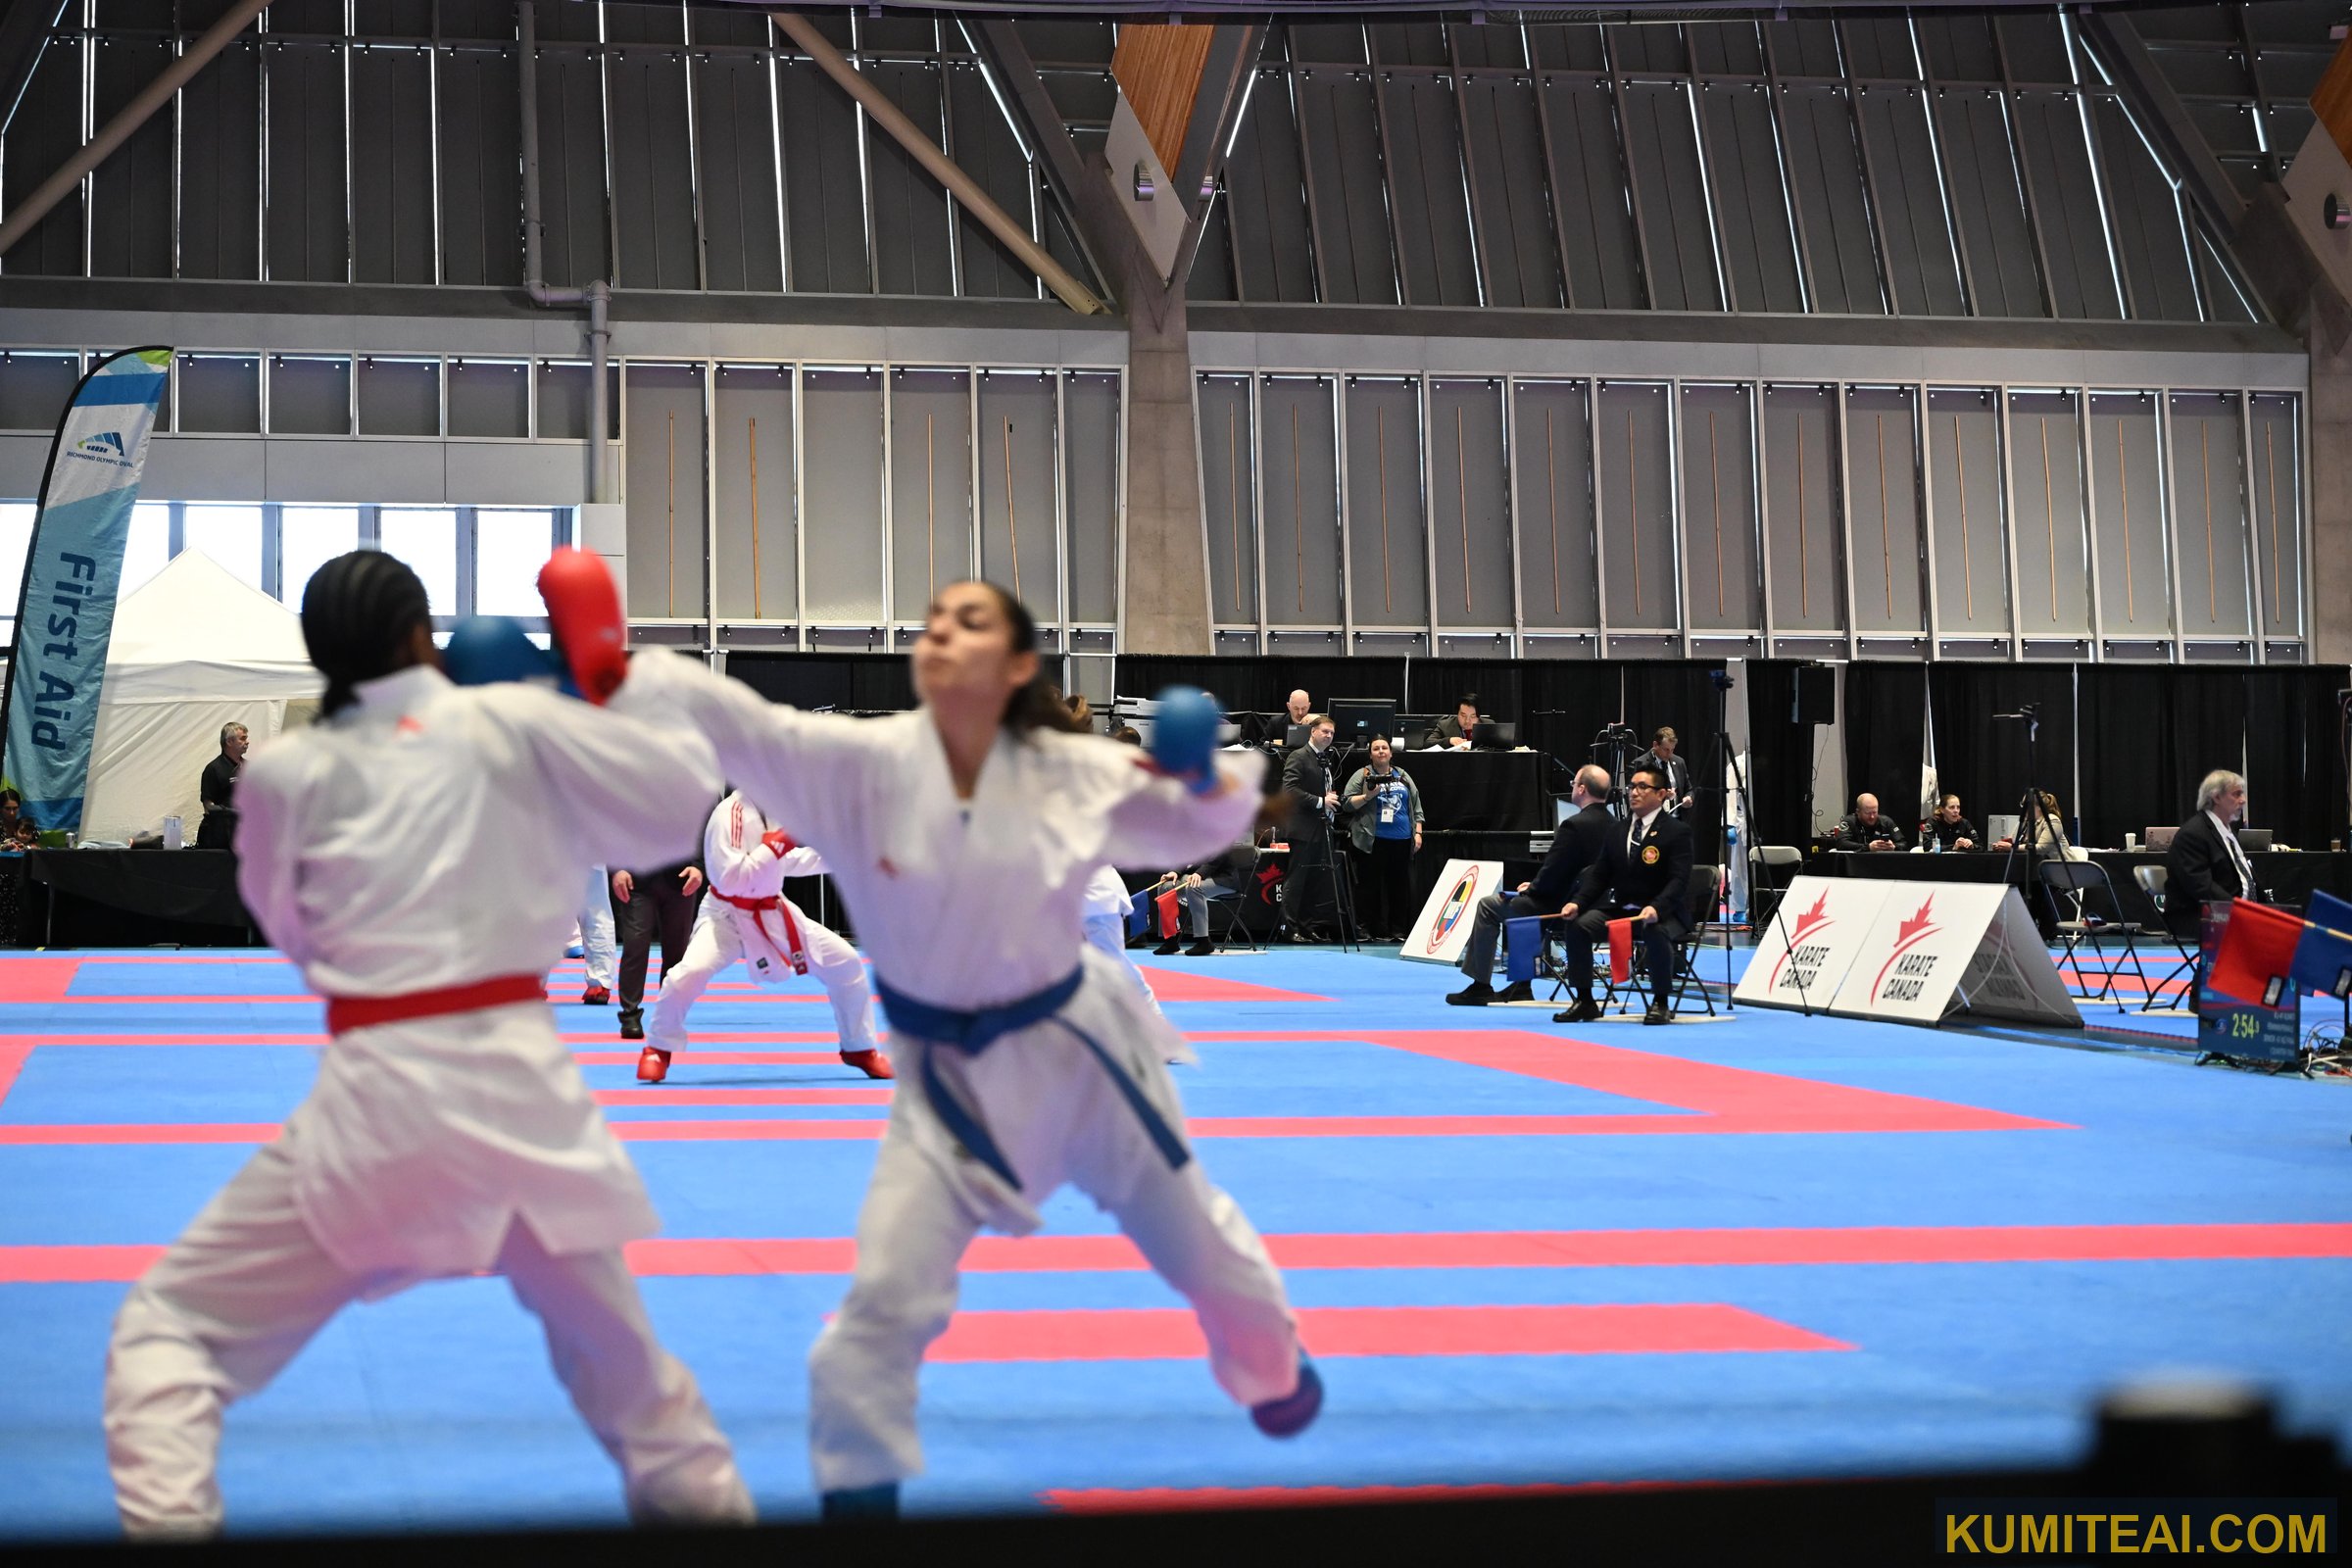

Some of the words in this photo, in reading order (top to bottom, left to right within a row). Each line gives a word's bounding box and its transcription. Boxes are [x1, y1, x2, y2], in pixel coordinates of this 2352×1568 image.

[67, 451, 96, 462] RICHMOND
[96, 456, 119, 466] OLYMPIC
[43, 552, 96, 661] First
[31, 670, 75, 751] Aid
[1793, 946, 1830, 966] KARATE
[1894, 954, 1937, 976] KARATE
[1780, 968, 1817, 990] CANADA
[1883, 978, 1924, 1001] CANADA
